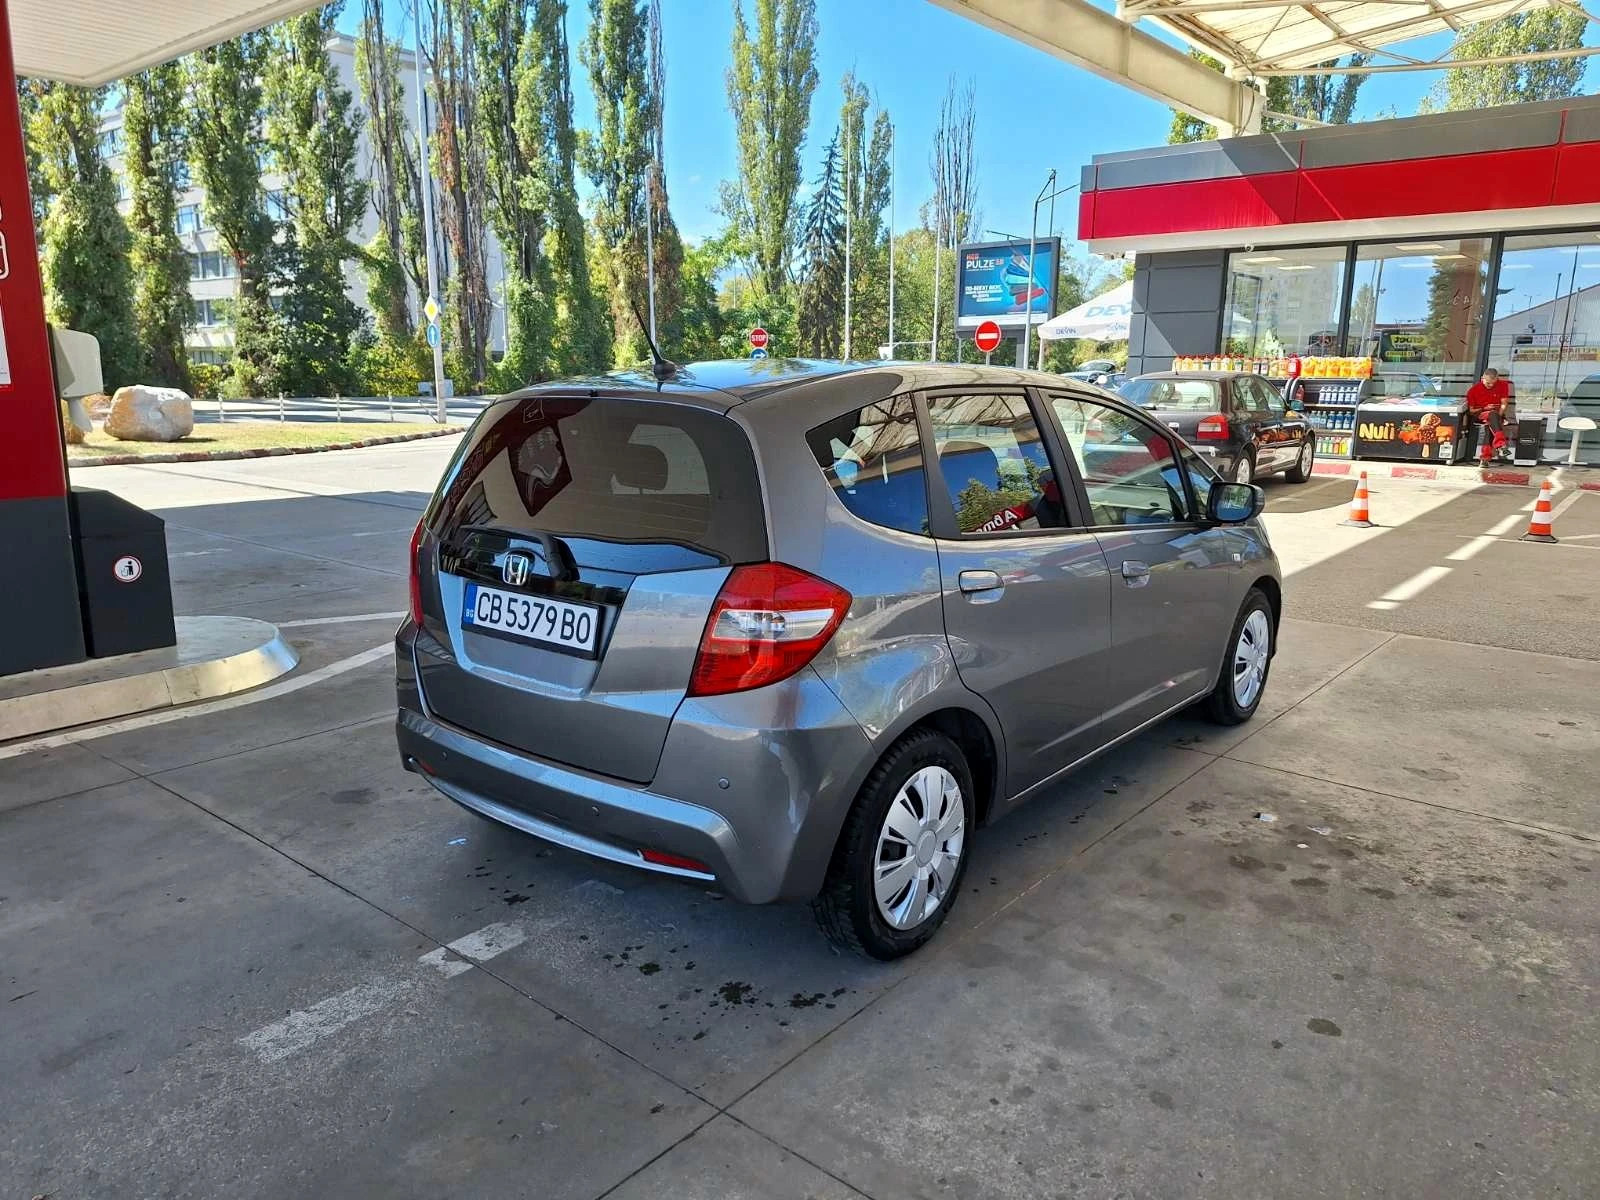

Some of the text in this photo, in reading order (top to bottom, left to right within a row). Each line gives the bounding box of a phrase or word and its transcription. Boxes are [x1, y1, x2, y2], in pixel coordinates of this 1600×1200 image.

[966, 259, 995, 269] PULZE
[1055, 327, 1077, 335] DEVIN
[751, 334, 766, 342] STOP
[1359, 422, 1395, 440] Nuii
